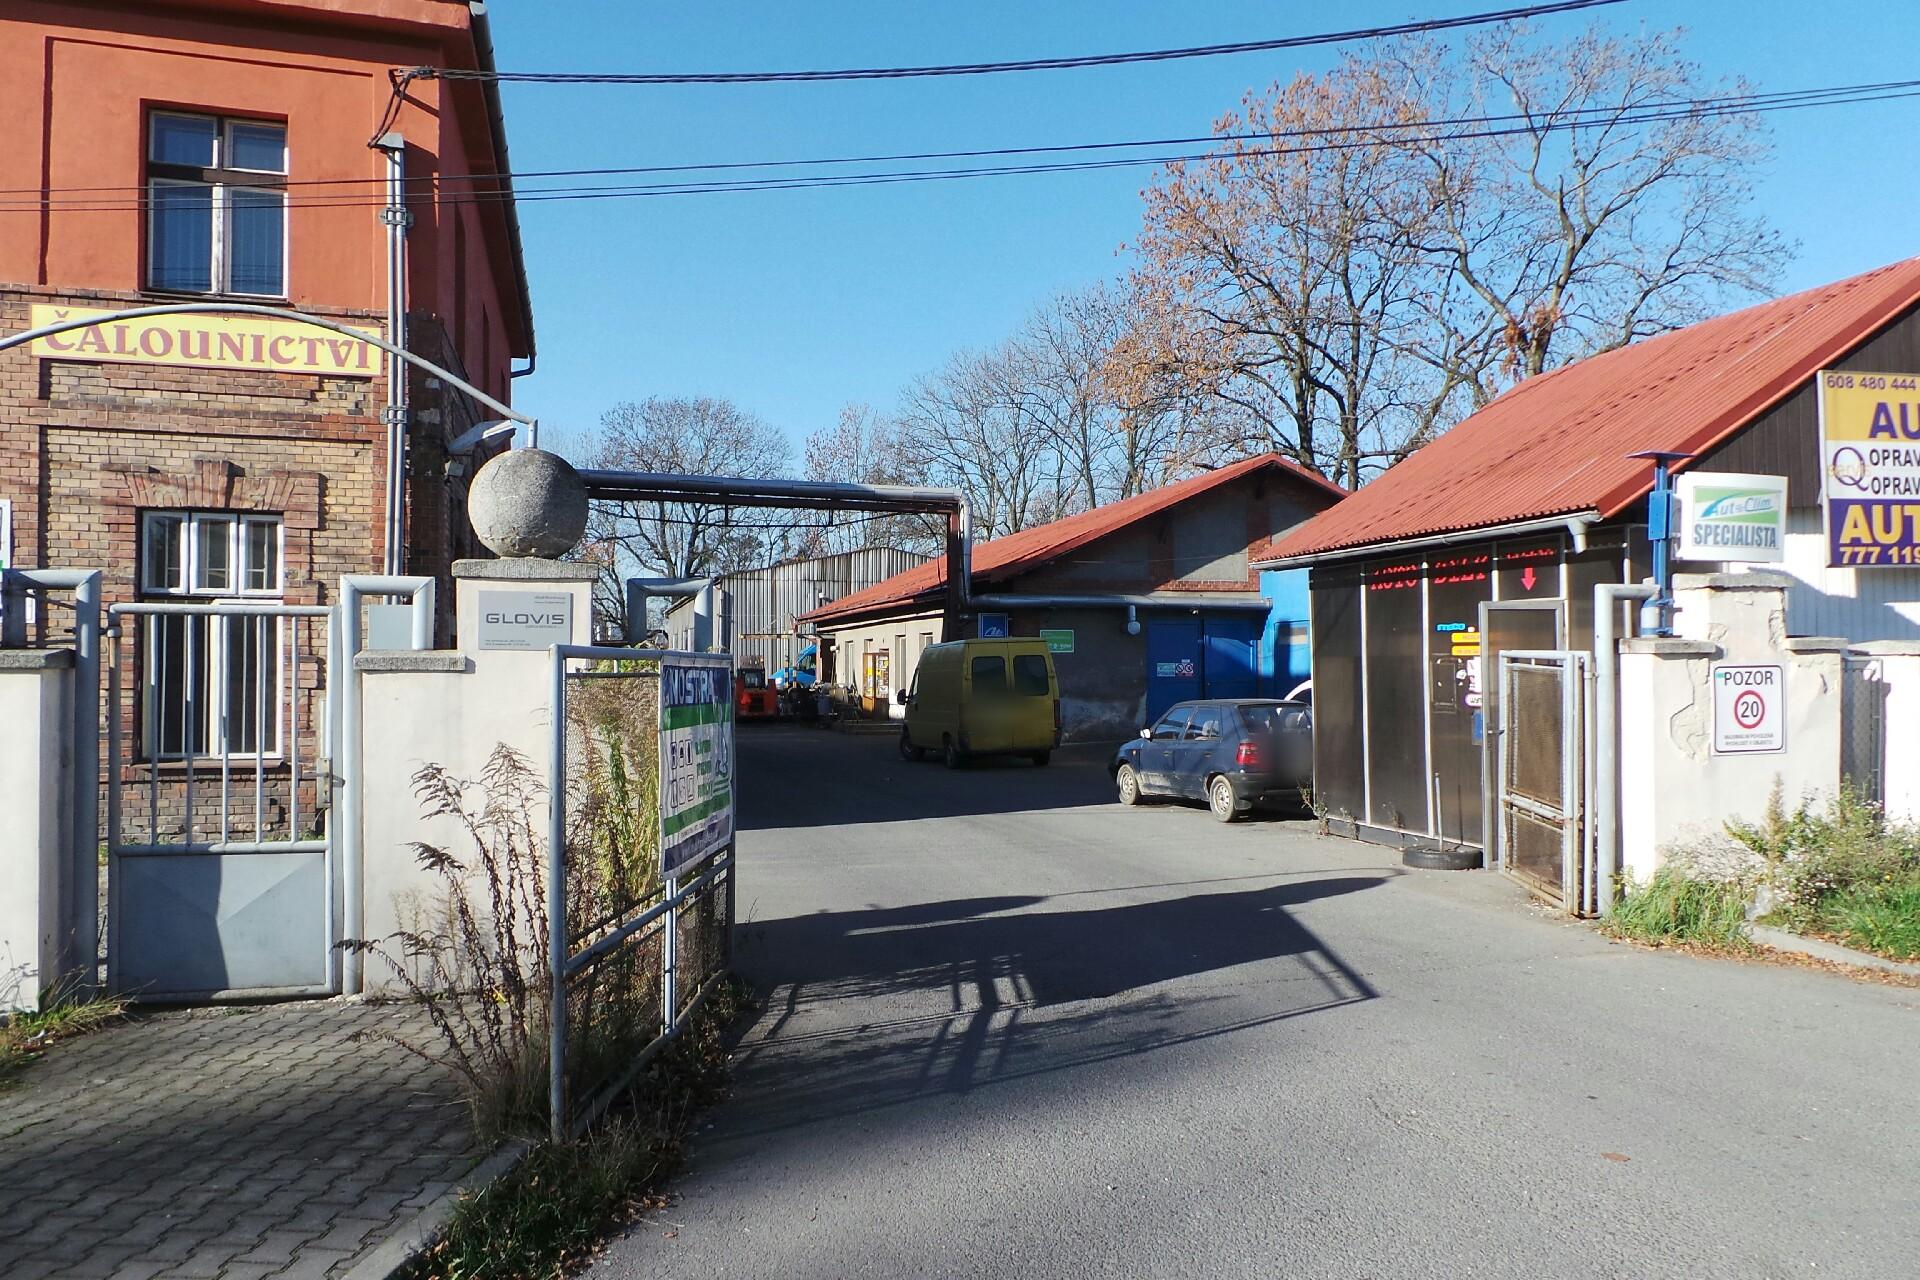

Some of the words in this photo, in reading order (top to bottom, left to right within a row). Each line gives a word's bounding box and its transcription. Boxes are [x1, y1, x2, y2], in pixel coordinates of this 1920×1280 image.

[1827, 375, 1854, 389] 608
[1859, 377, 1886, 390] 480
[1891, 377, 1917, 391] 444
[1694, 524, 1777, 548] SPECIALISTA
[1839, 546, 1881, 564] 777
[486, 613, 565, 625] GLOVIS
[1724, 670, 1774, 686] POZOR
[1740, 701, 1760, 718] 20
